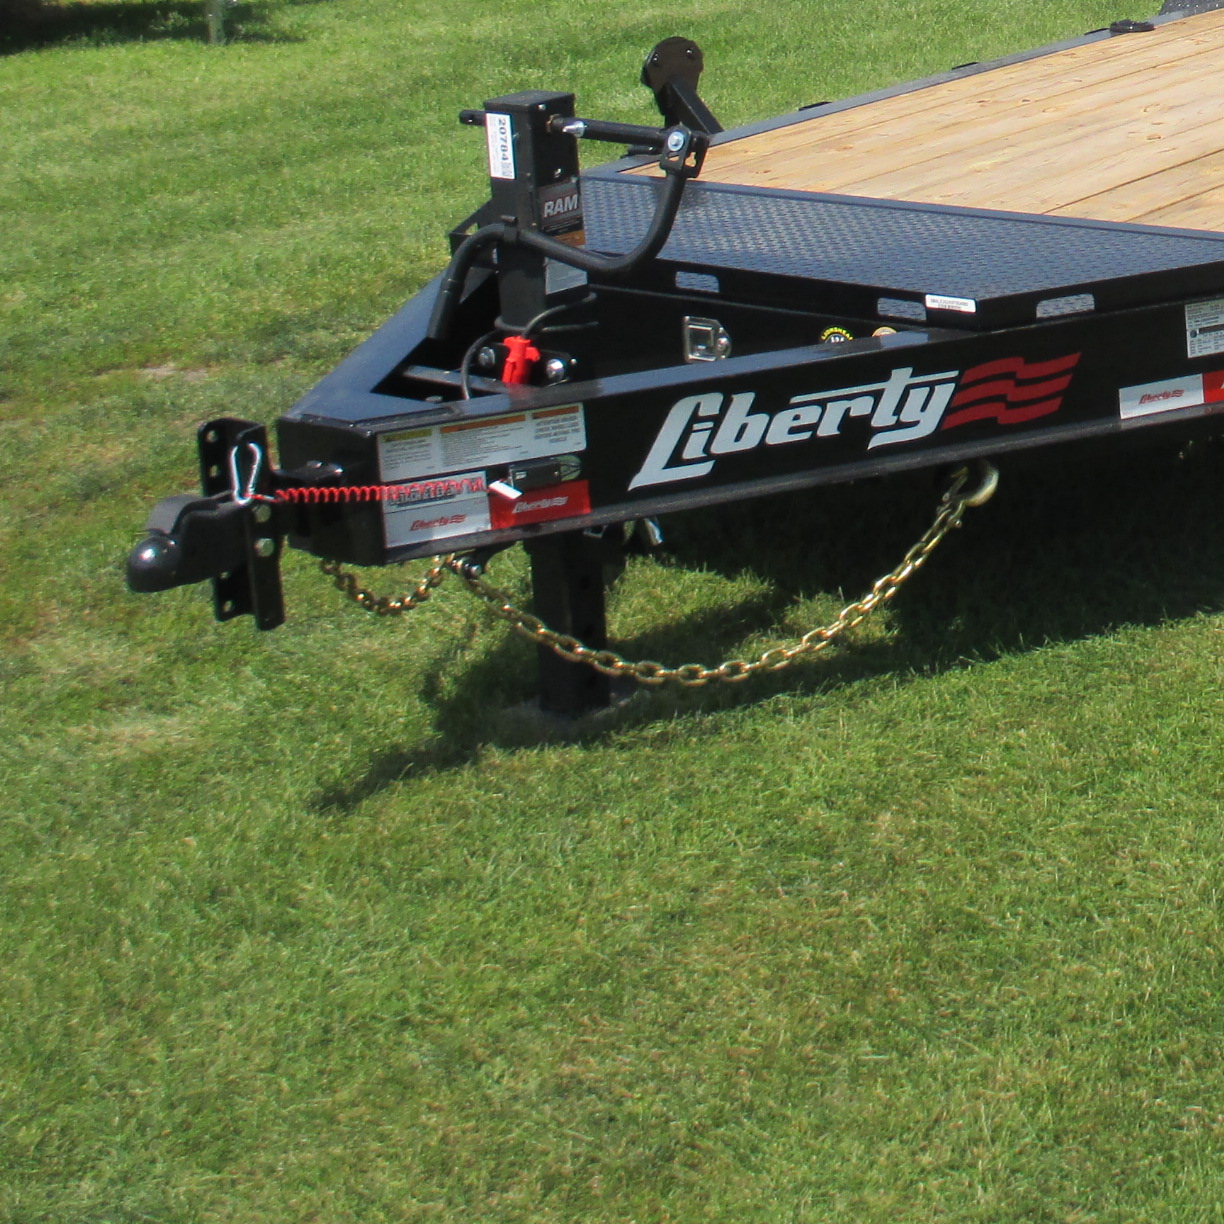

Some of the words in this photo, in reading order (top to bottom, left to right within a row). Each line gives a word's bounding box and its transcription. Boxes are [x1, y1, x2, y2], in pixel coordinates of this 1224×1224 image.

[498, 117, 509, 162] 20784
[543, 194, 579, 218] RAM
[627, 367, 960, 492] Liberty
